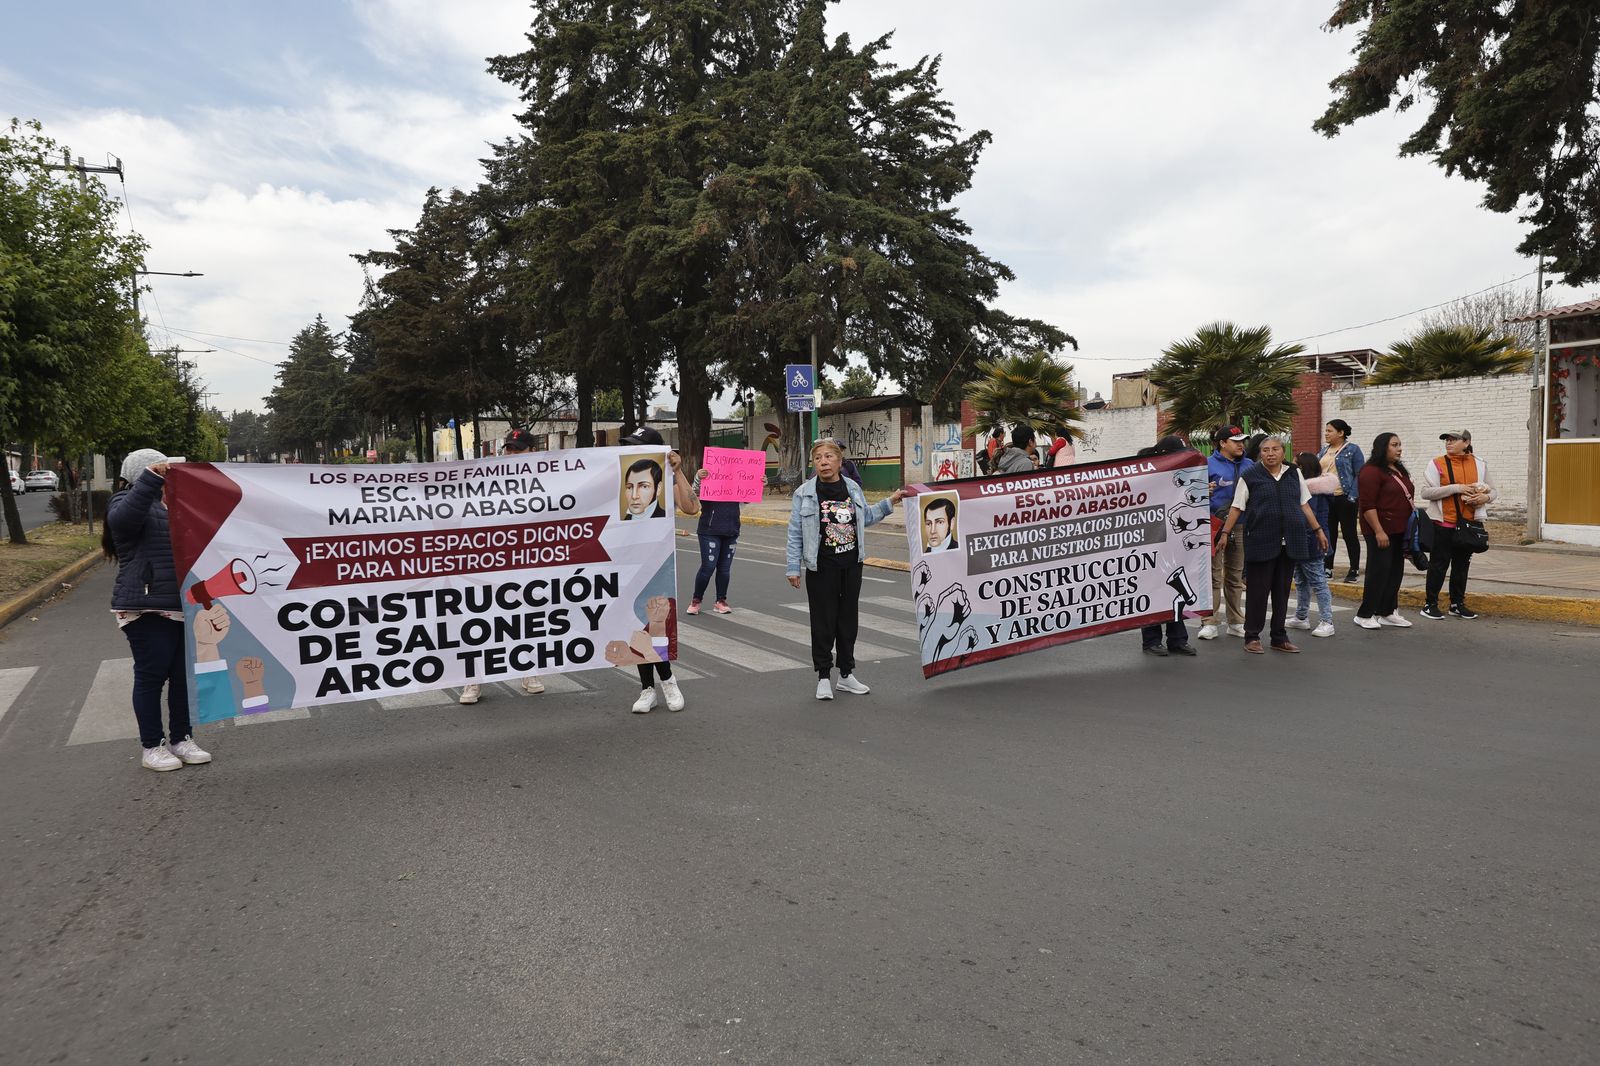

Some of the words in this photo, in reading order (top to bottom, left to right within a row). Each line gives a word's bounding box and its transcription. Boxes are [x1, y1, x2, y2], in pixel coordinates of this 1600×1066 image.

[310, 472, 347, 485] LOS
[353, 472, 429, 484] PADRES
[434, 470, 459, 482] DE
[463, 462, 532, 479] FAMILIA
[537, 460, 560, 473] DE
[564, 458, 586, 472] LA
[360, 485, 416, 504] ESC.
[424, 477, 546, 501] PRIMARIA
[979, 482, 1004, 495] LOS
[1005, 476, 1054, 492] PADRES
[1055, 473, 1072, 485] DE
[1073, 467, 1121, 483] FAMILIA
[1121, 464, 1139, 476] DE
[1139, 462, 1157, 473] LA
[328, 502, 454, 526] MARIANO
[461, 494, 576, 518] ABASOLO
[993, 504, 1073, 528] MARIANO
[1075, 491, 1148, 516] ABASOLO
[1014, 493, 1051, 509] ESC.
[1053, 480, 1132, 503] PRIMARIA
[305, 537, 416, 564] ¡EXIGIMOS
[422, 529, 518, 553] ESPACIOS
[523, 522, 594, 545] DIGNOS
[969, 527, 1047, 556] ¡EXIGIMOS
[1049, 516, 1113, 540] ESPACIOS
[1113, 508, 1165, 529] DIGNOS
[990, 548, 1029, 568] PARA
[1031, 536, 1101, 561] NUESTROS
[1103, 528, 1145, 549] HIJOS!
[336, 560, 395, 581] PARA
[401, 551, 506, 576] NUESTROS
[511, 545, 571, 566] HIJOS!
[977, 549, 1159, 601] CONSTRUCCIÓN
[277, 568, 620, 632] CONSTRUCCIÓN
[999, 595, 1032, 620] DE
[1036, 575, 1138, 612] SALONES
[298, 631, 362, 666] DE
[376, 608, 571, 657] SALONES
[580, 604, 608, 632] Y
[985, 623, 1002, 645] Y
[1007, 609, 1071, 641] ARCO
[1076, 594, 1151, 625] TECHO
[315, 655, 445, 699] ARCO
[456, 637, 595, 679] TECHO
